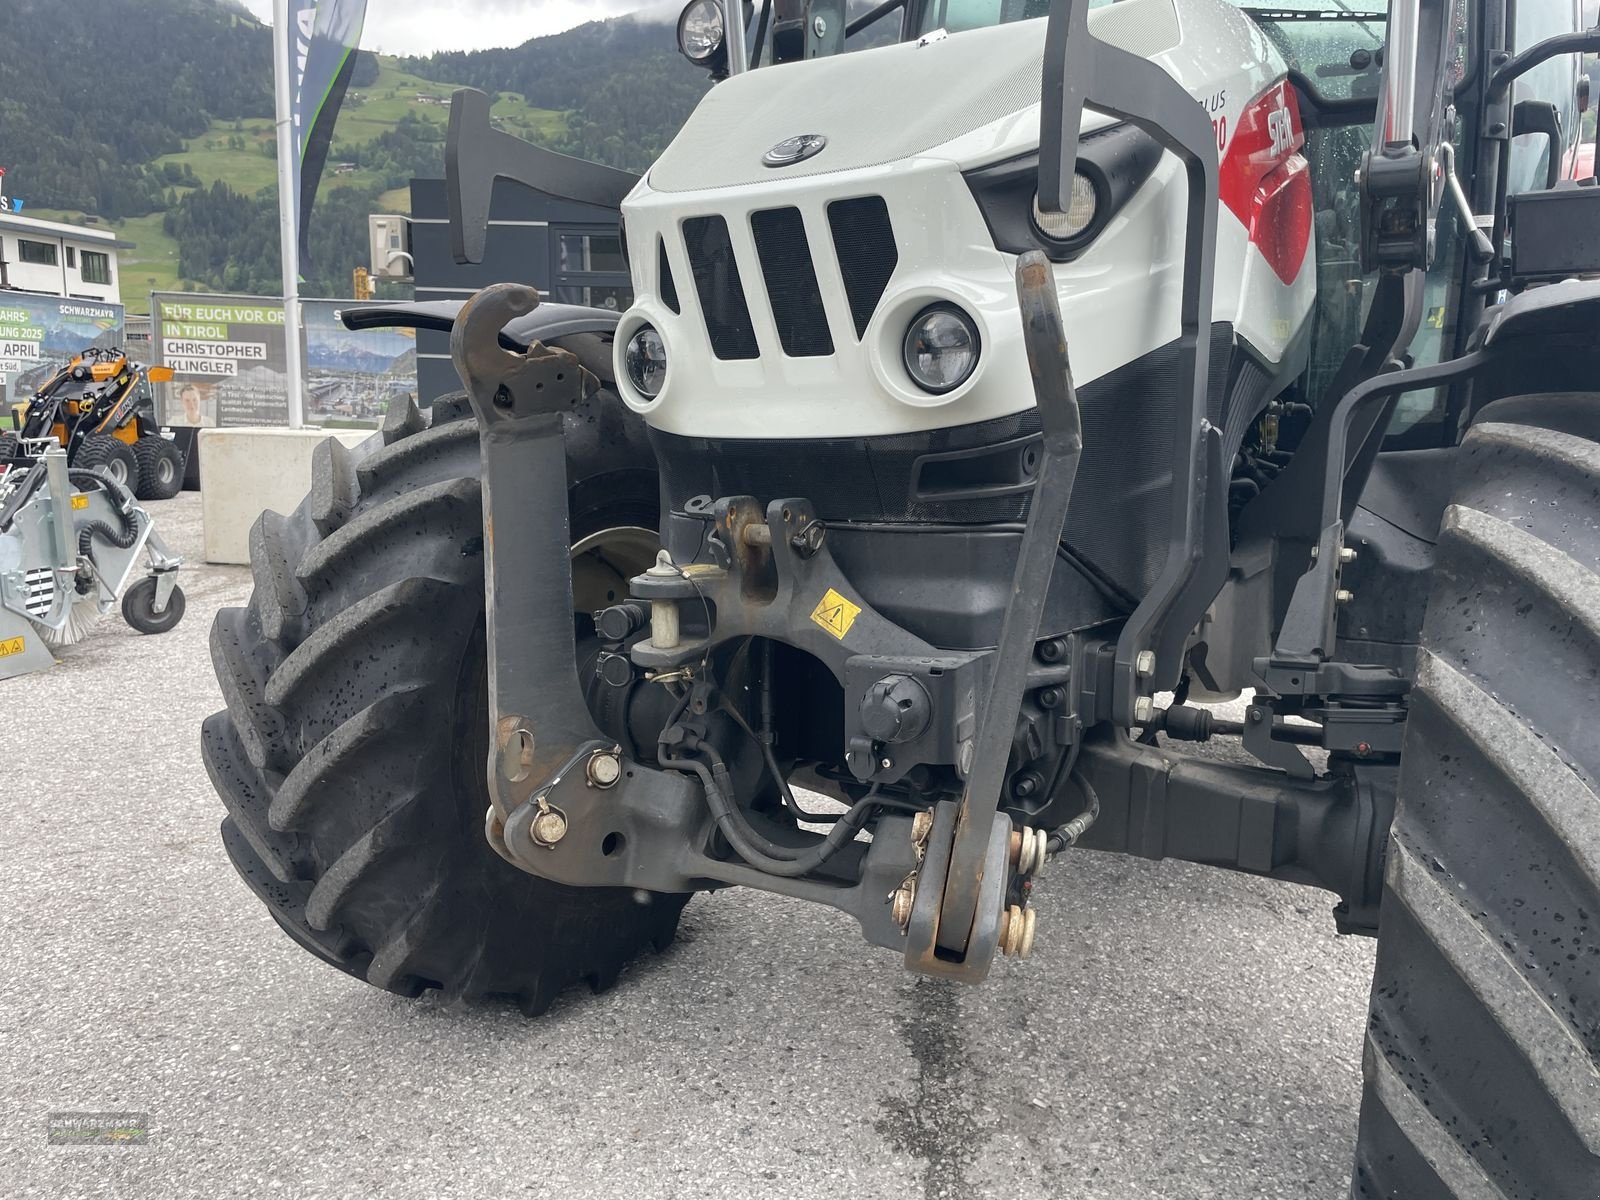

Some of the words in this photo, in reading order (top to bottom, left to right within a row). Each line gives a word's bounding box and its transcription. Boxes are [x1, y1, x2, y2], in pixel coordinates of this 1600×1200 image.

[1199, 90, 1226, 112] LUS
[59, 305, 114, 318] SCHWARZMAYR
[165, 305, 192, 319] FÜR
[196, 307, 232, 321] EUCH
[234, 309, 264, 322] VOR
[267, 310, 286, 323] OR
[21, 328, 43, 339] 2025
[167, 324, 180, 336] IN
[183, 326, 225, 338] TIROL
[3, 343, 38, 357] APRIL
[167, 342, 263, 357] CHRISTOPHER
[168, 360, 234, 374] KLINGLER
